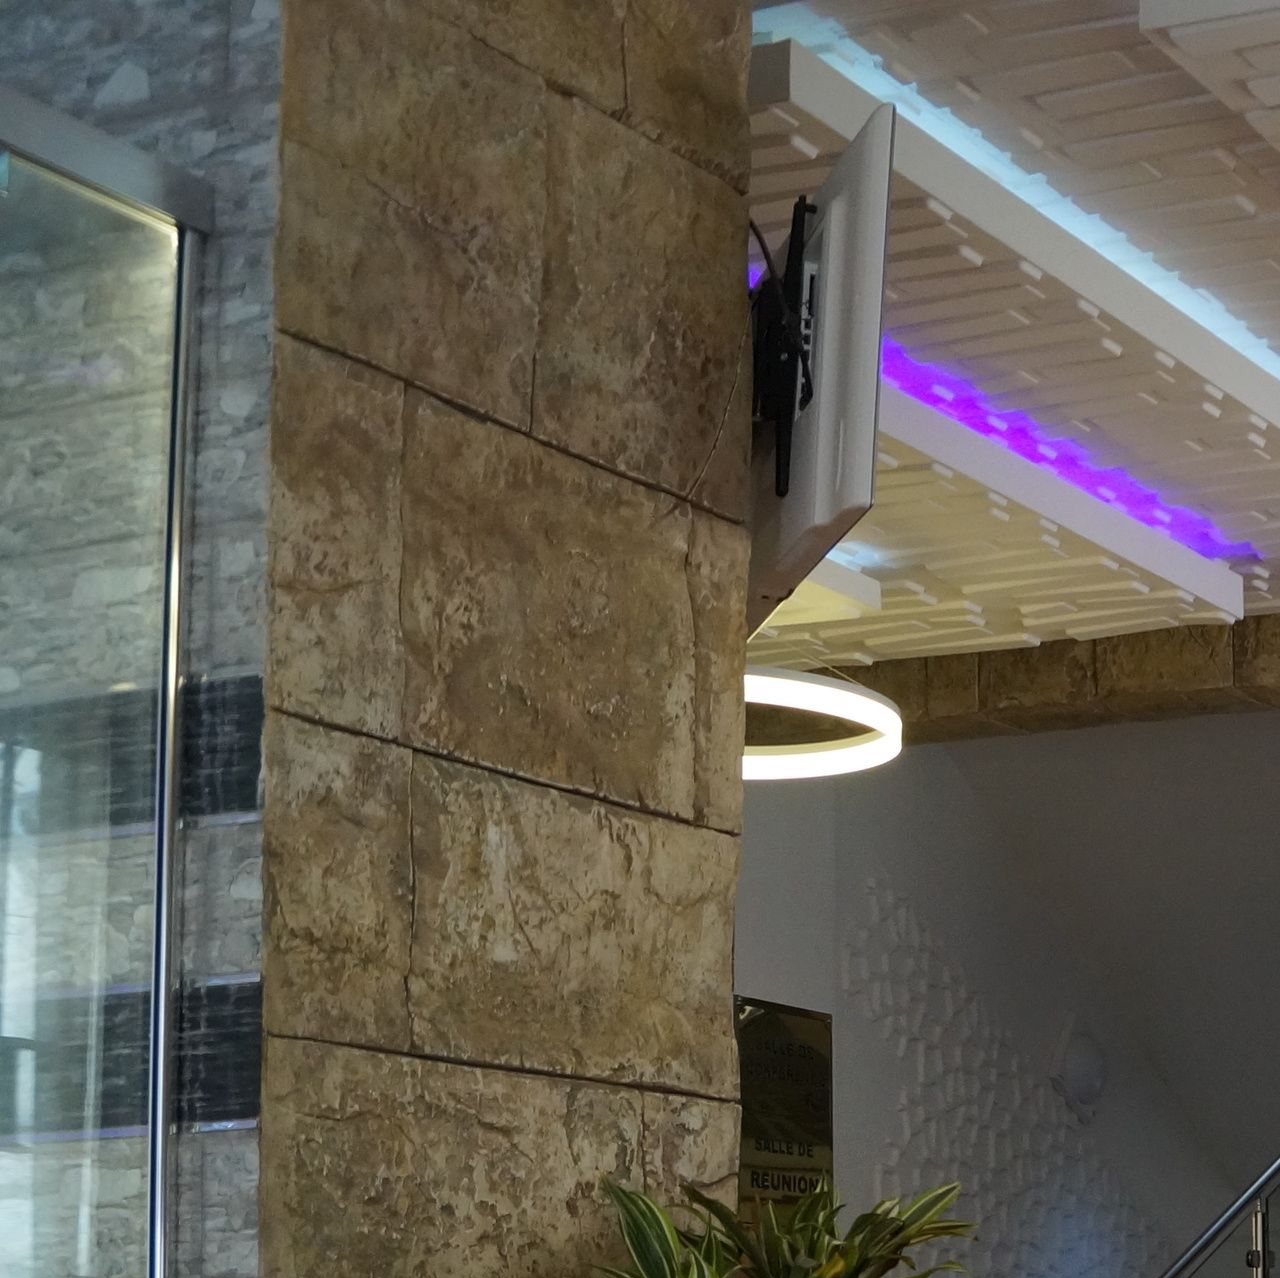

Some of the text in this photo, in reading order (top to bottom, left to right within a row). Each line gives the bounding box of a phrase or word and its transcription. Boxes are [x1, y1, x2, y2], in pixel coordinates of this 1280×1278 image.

[755, 1137, 814, 1158] SALLE DE
[751, 1169, 819, 1194] REUNION
